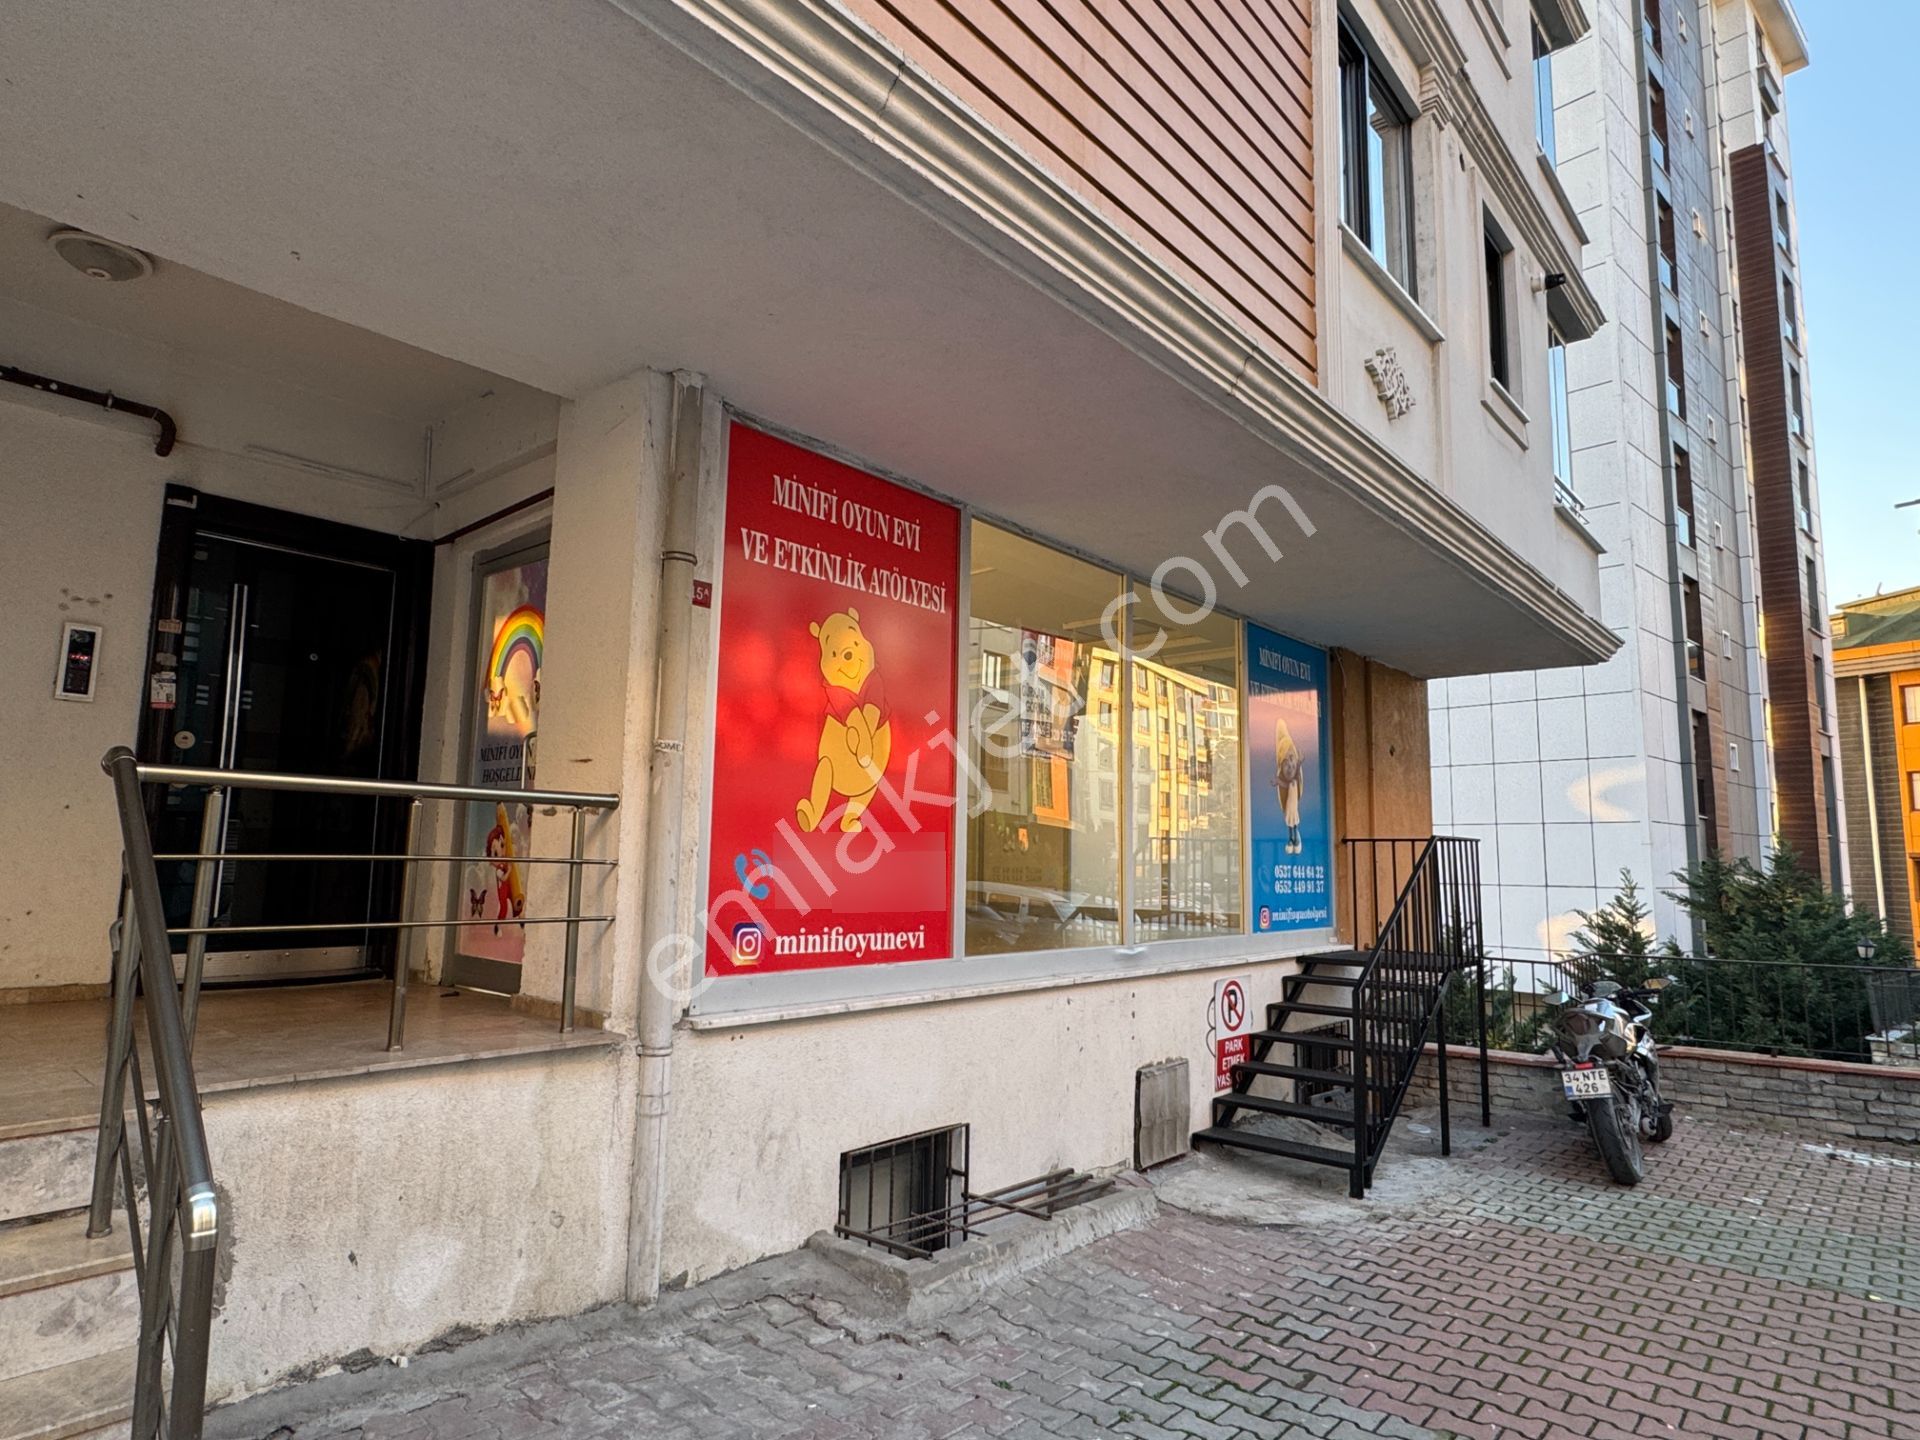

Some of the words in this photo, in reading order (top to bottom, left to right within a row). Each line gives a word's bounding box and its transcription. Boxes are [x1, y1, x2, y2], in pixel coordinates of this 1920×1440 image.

[772, 474, 838, 525] MİNİFİ
[842, 500, 890, 541] OYUN
[893, 518, 921, 552] EVİ
[741, 527, 769, 564] VE
[774, 543, 866, 591] ETKİNLİK
[869, 566, 946, 614] ATÖLYESİ
[774, 925, 925, 958] minifioyunevi
[1225, 1037, 1243, 1054] PARK
[1564, 1073, 1580, 1084] 34
[1582, 1070, 1606, 1081] NTE
[1576, 1083, 1599, 1094] 426
